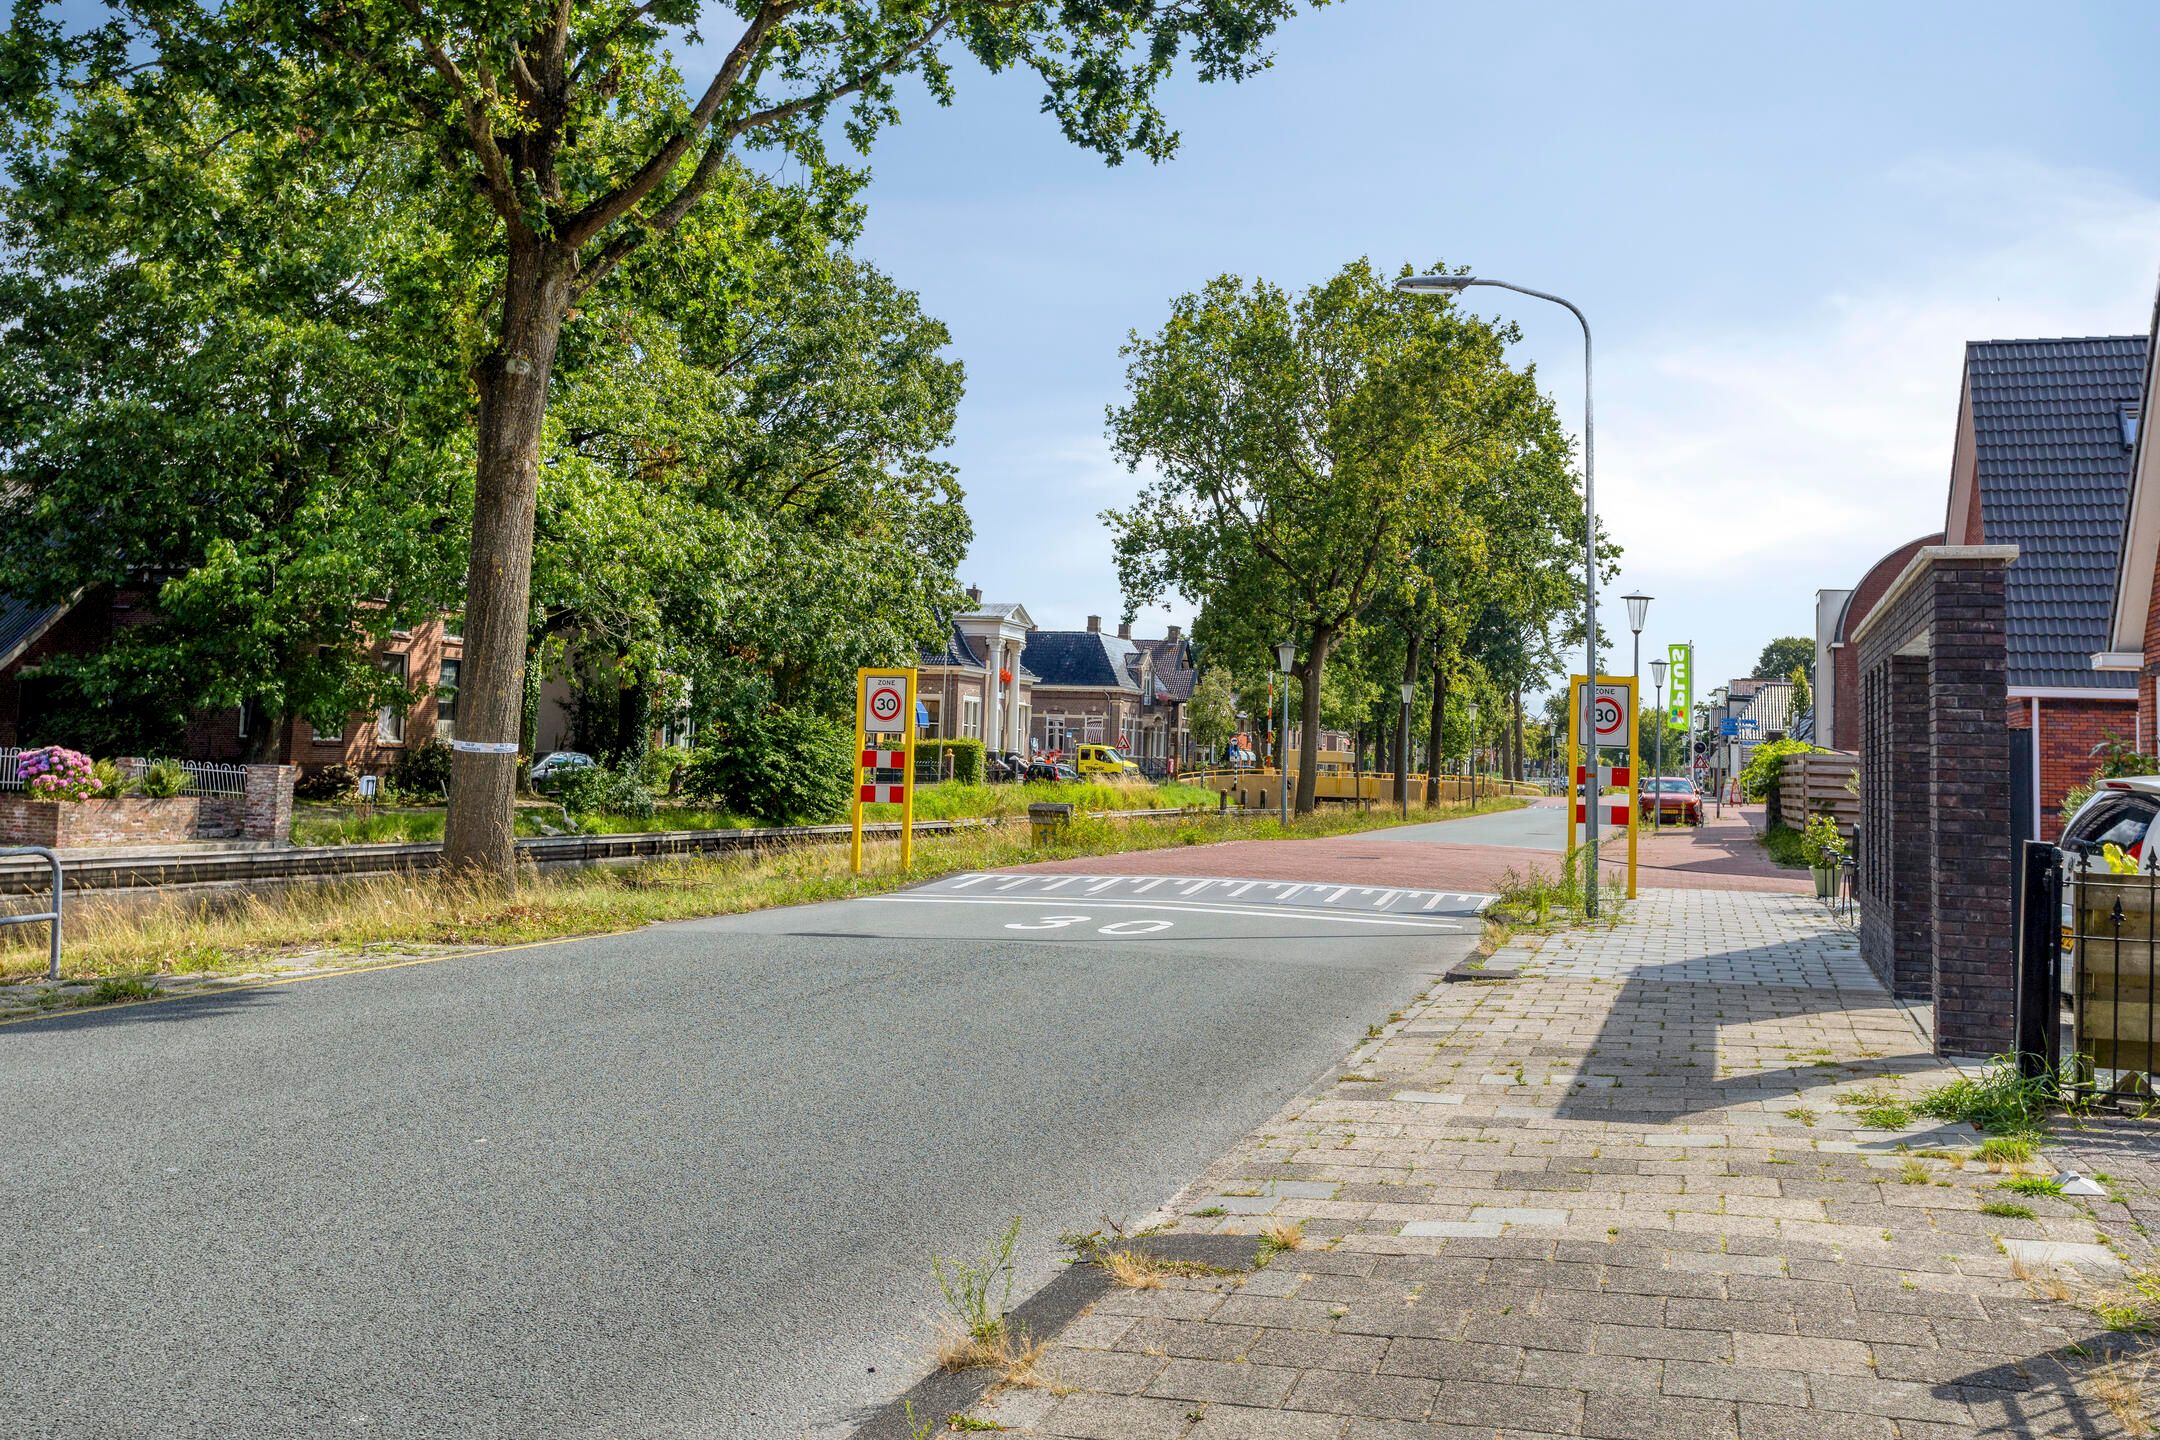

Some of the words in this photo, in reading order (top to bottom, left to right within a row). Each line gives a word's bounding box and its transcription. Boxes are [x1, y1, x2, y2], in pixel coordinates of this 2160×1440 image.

[876, 698, 896, 711] 30
[1595, 709, 1617, 722] 30
[1004, 915, 1175, 935] 30
